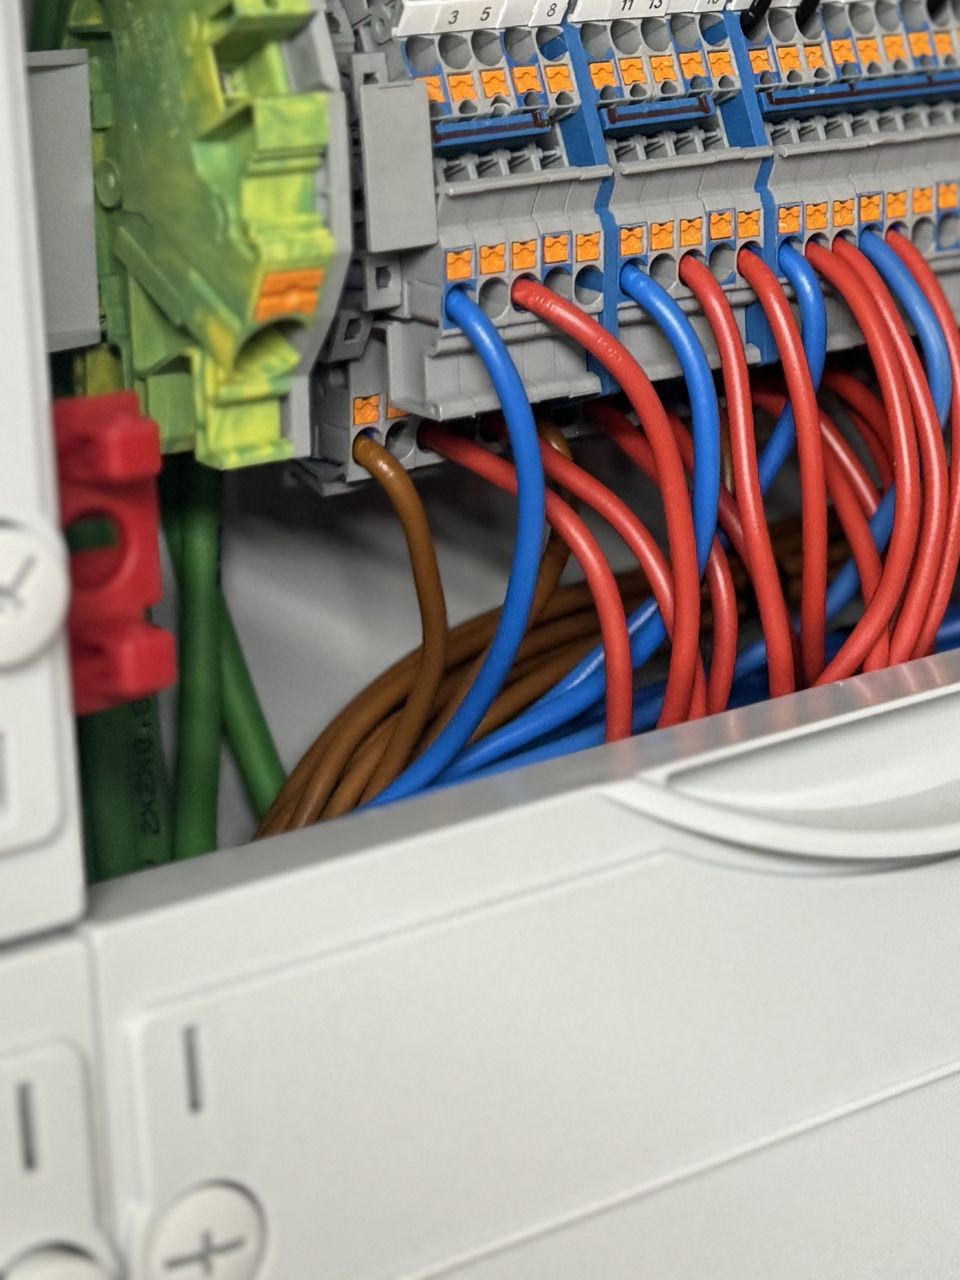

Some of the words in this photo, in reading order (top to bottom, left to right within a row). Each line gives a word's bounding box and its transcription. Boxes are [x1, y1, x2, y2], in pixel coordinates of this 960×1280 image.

[448, 10, 459, 24] 3
[480, 7, 492, 21] 5
[547, 3, 557, 17] 8
